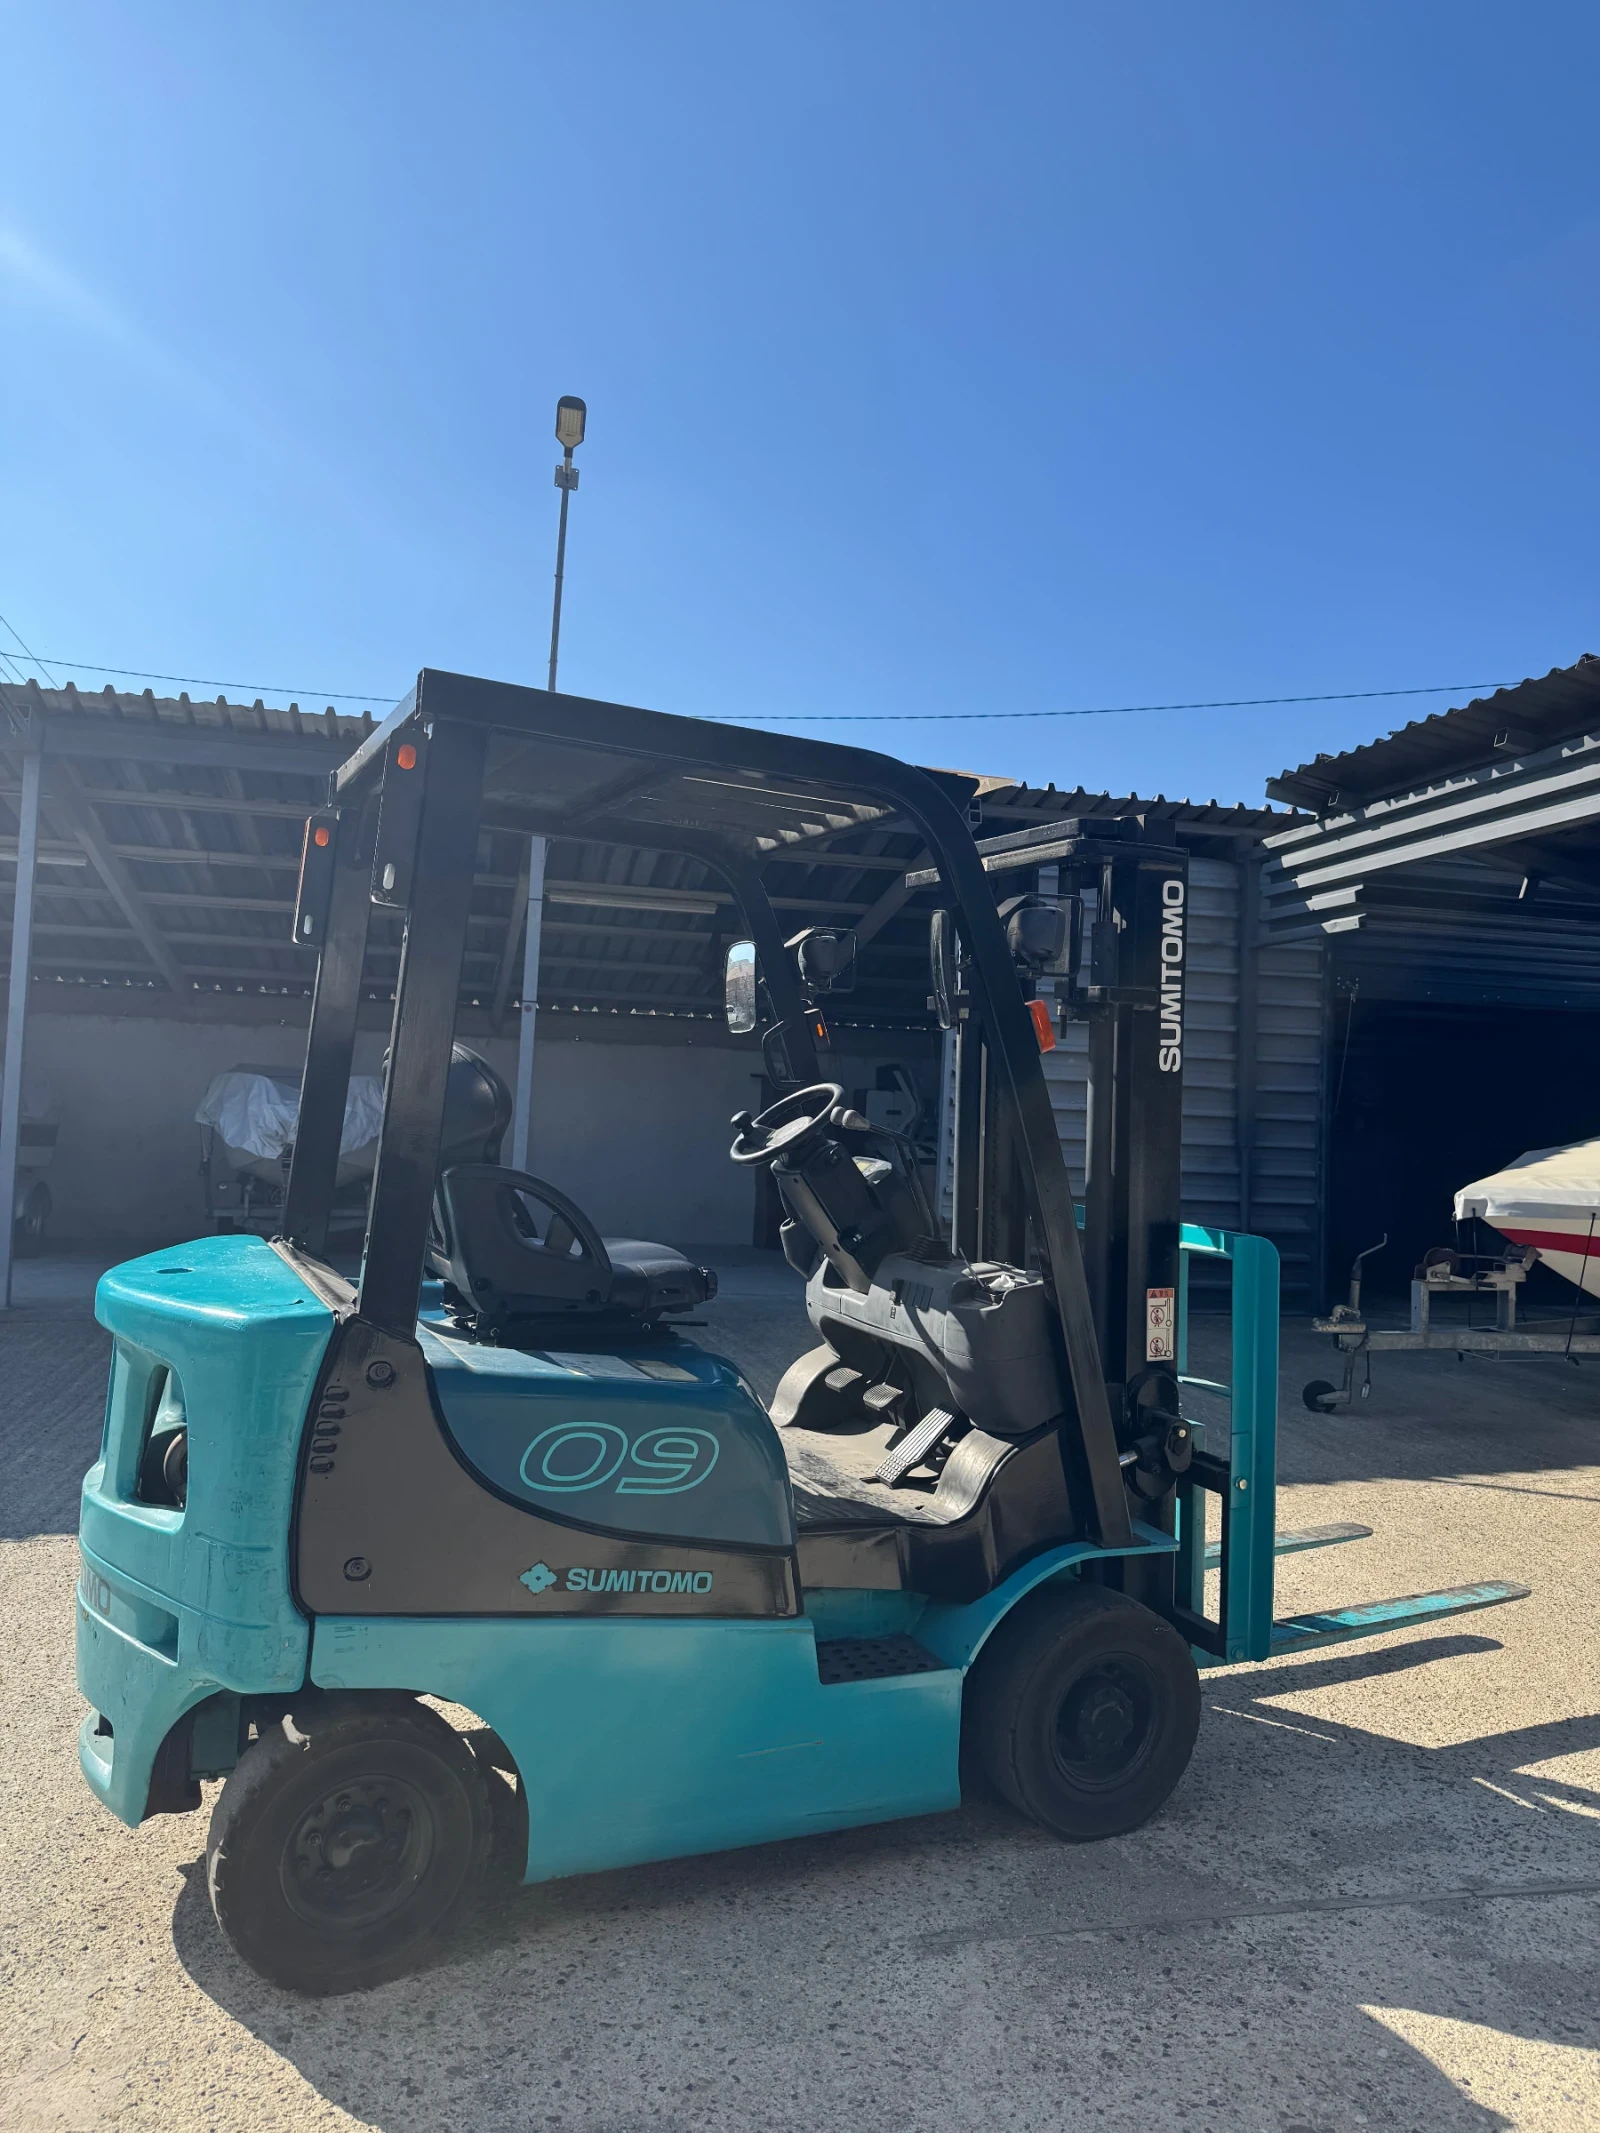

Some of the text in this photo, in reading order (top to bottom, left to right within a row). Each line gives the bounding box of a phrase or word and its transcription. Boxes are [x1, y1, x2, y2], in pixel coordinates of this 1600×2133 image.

[1159, 880, 1185, 1073] SUMITOMO
[519, 1421, 720, 1494] 09
[565, 1567, 713, 1593] SUMITOMO
